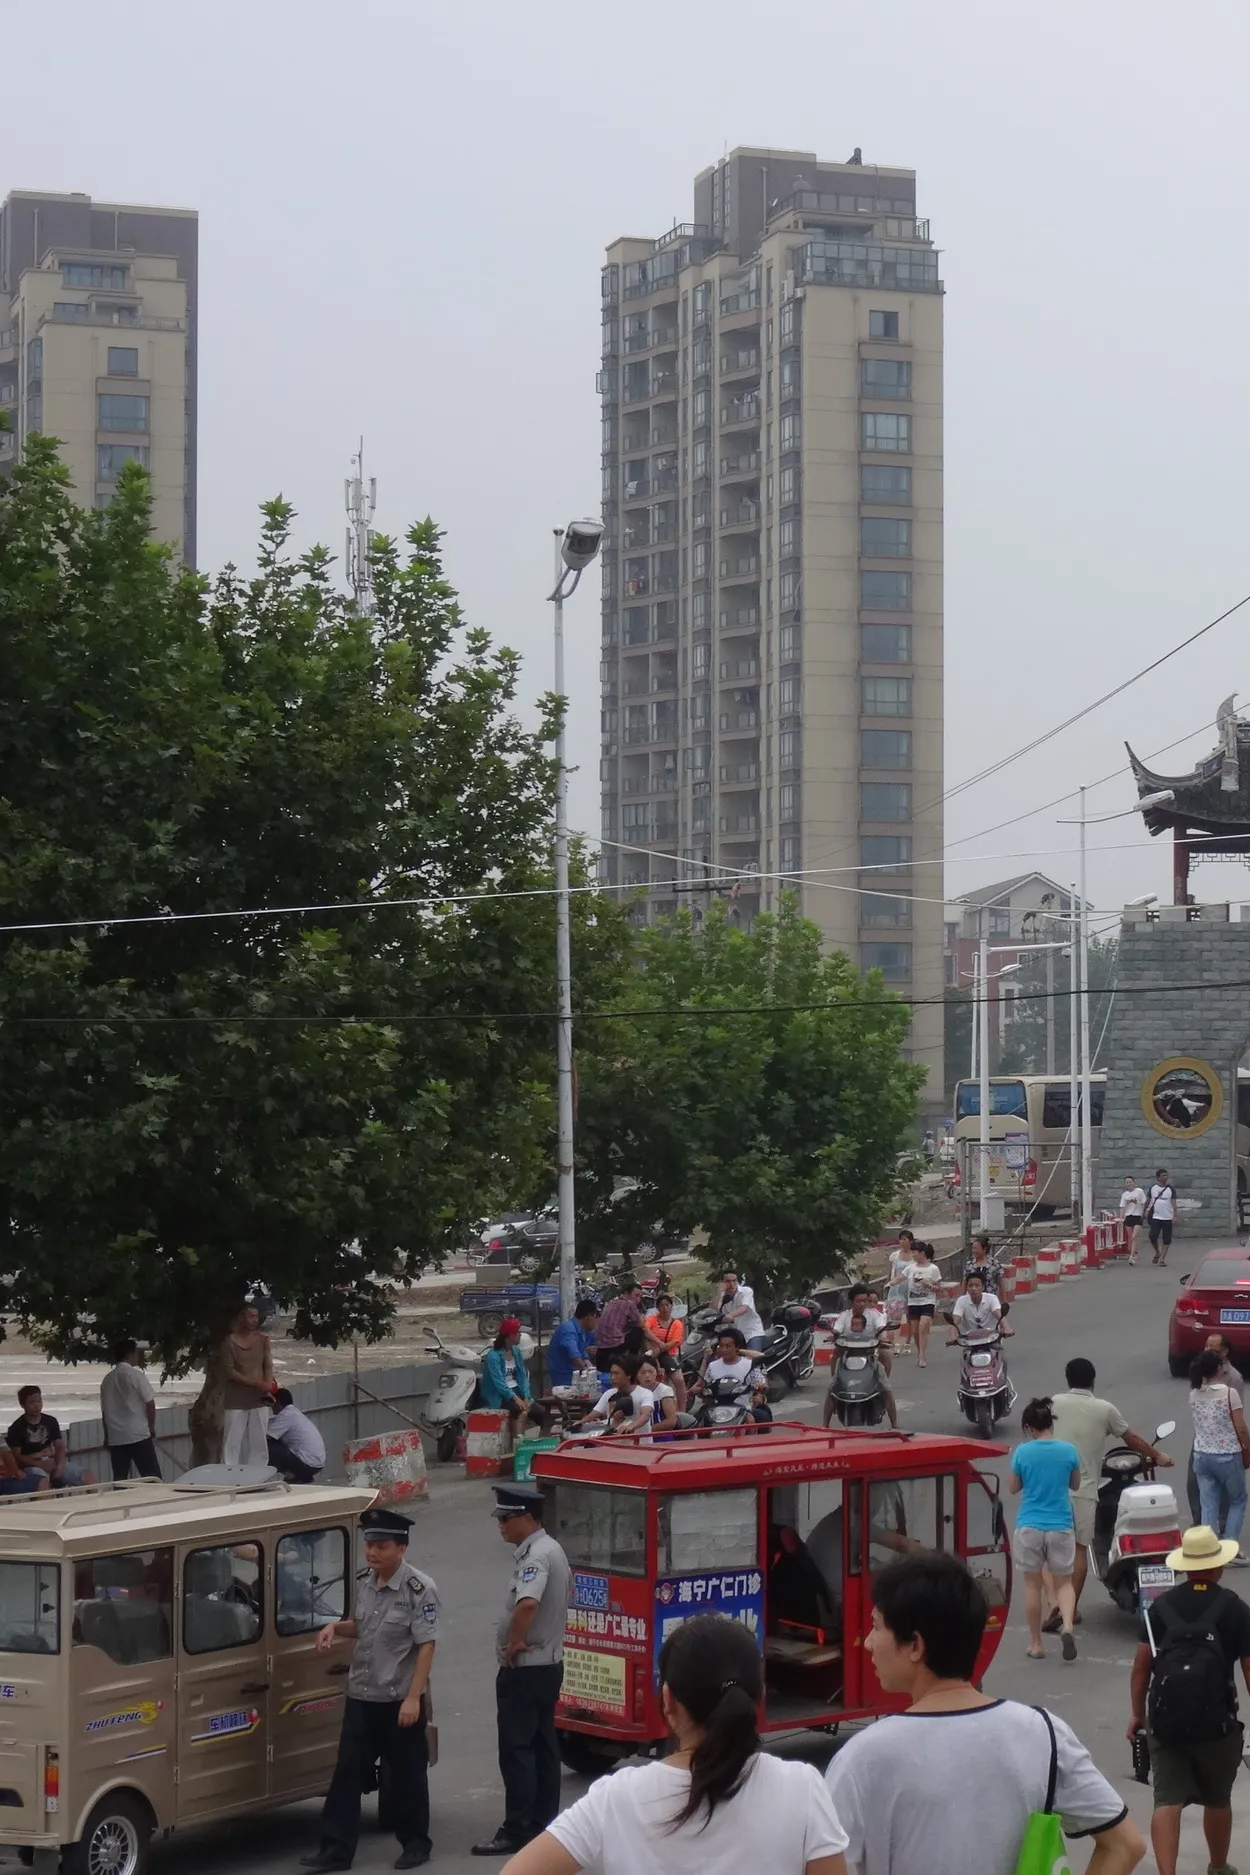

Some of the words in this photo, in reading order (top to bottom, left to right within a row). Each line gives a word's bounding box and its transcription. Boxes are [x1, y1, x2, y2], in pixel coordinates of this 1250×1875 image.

[583, 1588, 604, 1607] 0625
[678, 1573, 761, 1603] 海宁广仁门诊
